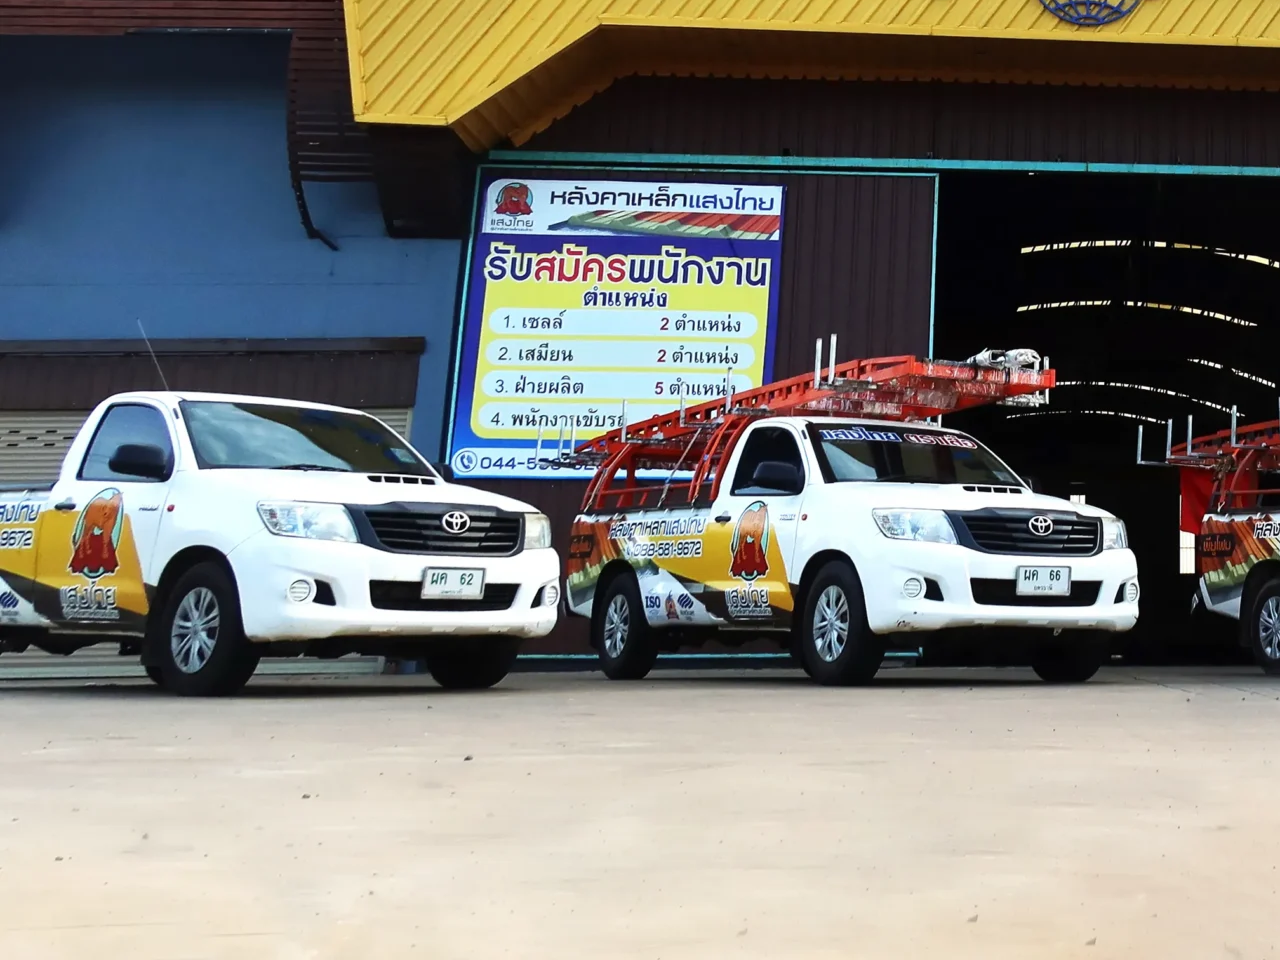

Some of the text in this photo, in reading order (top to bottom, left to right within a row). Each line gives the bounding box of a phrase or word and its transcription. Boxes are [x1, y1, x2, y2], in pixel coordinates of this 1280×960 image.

[490, 217, 534, 228] แสงไทย
[486, 244, 768, 286] รับสมัครพนักงาน
[583, 286, 668, 308] ตำแหน่ง
[503, 309, 742, 333] 1. เซลล์ 2 ตำแหน่ง
[497, 342, 739, 365] 2. เสมียน 2 ตำแหน่ง
[494, 378, 509, 394] 3.
[514, 374, 584, 395] ฝ่ายผลิต
[654, 381, 664, 395] 5
[490, 411, 505, 427] 4.
[459, 572, 474, 586] 62
[1049, 569, 1061, 581] 66
[645, 596, 661, 609] ISO
